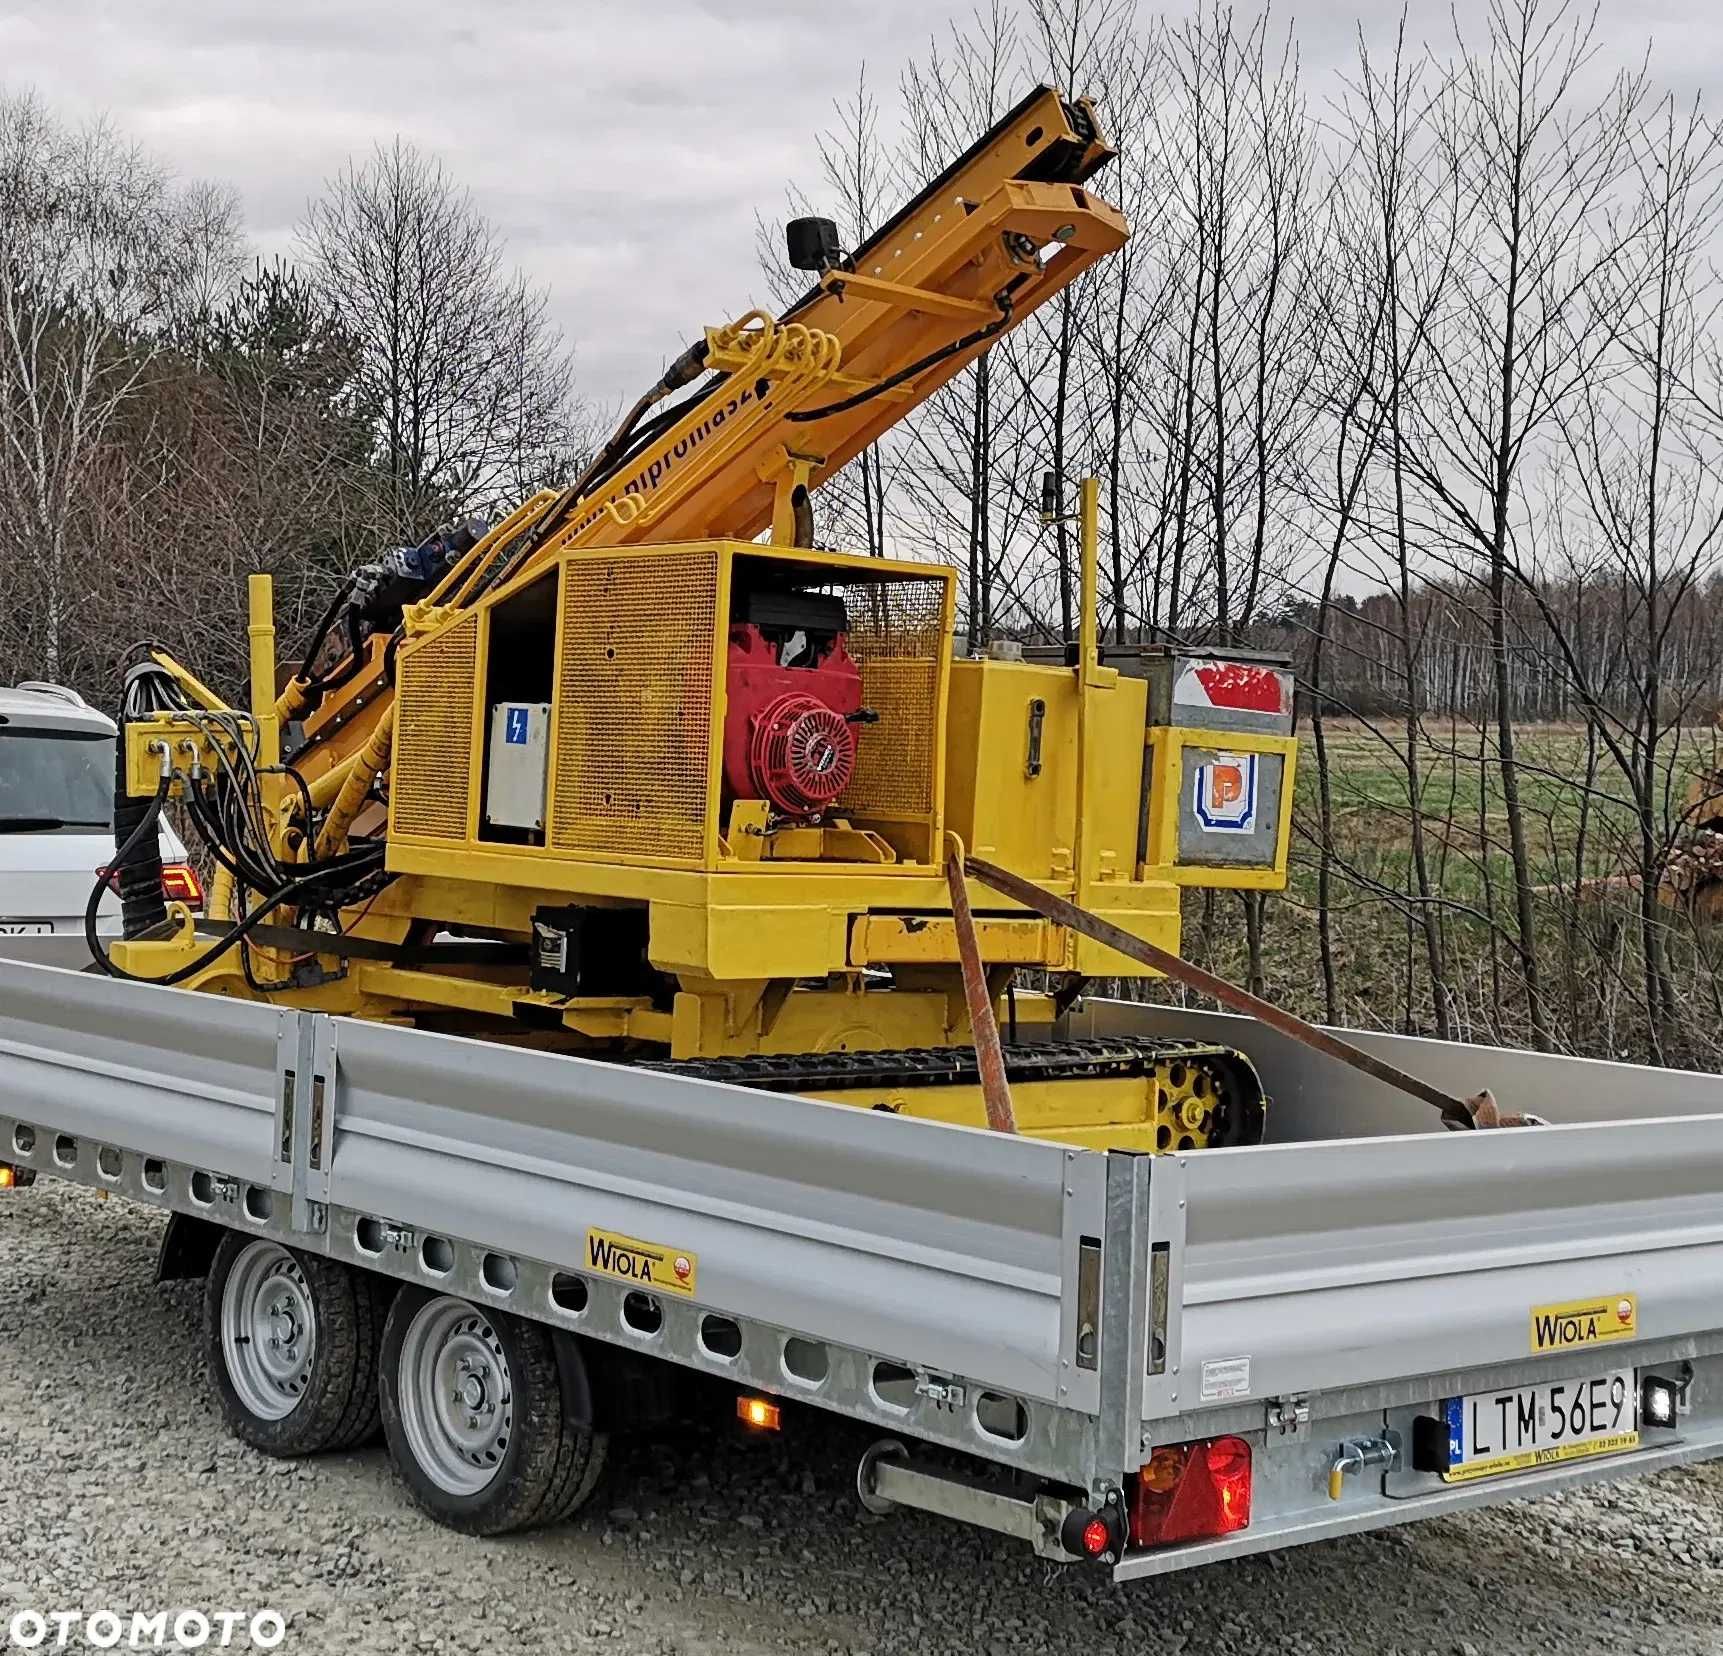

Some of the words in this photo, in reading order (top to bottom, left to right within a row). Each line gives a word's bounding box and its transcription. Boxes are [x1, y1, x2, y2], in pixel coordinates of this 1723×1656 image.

[589, 1235, 651, 1282] WIOLA
[1535, 1315, 1597, 1348] WIOLA
[1473, 1391, 1536, 1456] LTM
[1550, 1376, 1625, 1440] 56E9
[1449, 1439, 1462, 1455] PL
